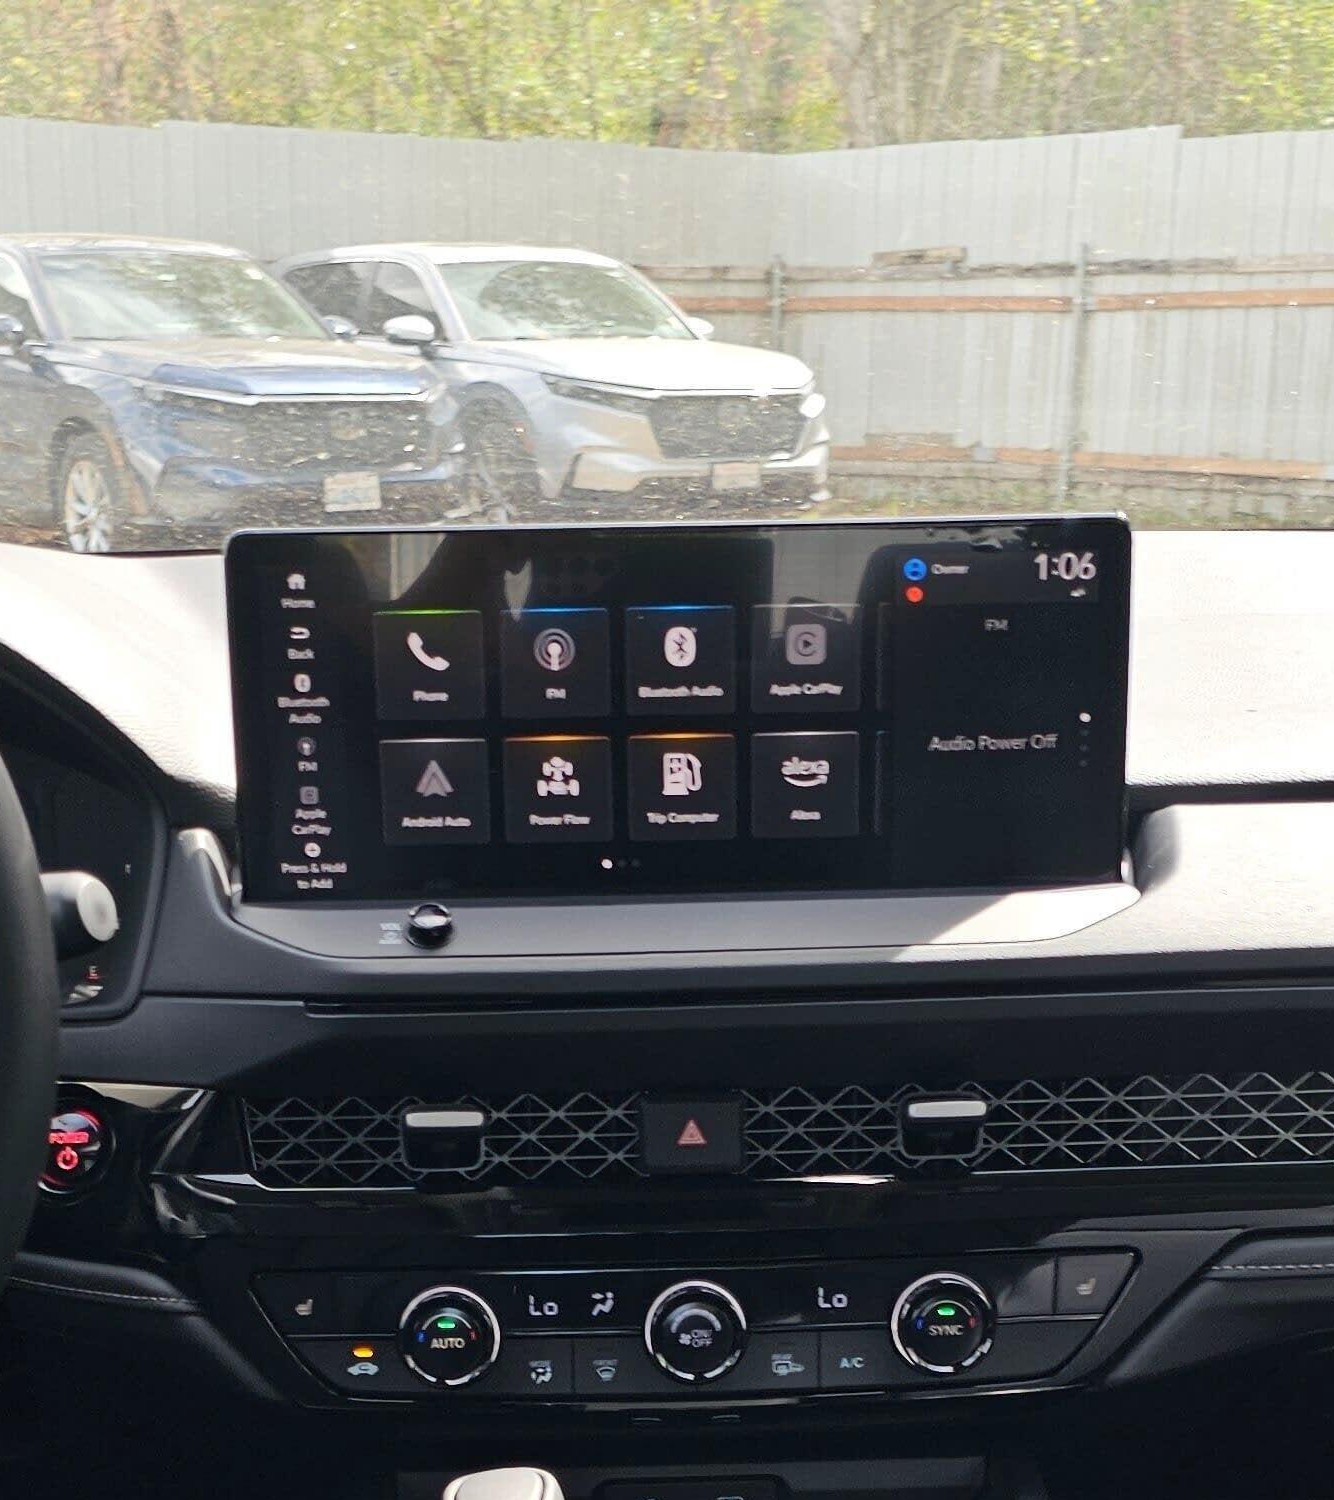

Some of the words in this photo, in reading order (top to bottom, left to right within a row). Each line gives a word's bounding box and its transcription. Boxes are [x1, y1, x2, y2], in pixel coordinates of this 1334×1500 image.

[1034, 552, 1097, 581] 1:06
[280, 598, 316, 608] Home
[984, 619, 1008, 631] FM
[287, 648, 315, 660] Back
[545, 687, 566, 699] FM
[638, 685, 690, 698] Bluetooth
[691, 685, 724, 698] Audio
[769, 683, 801, 696] Apple
[801, 682, 843, 695] CarPlay
[277, 696, 331, 708] Bluetooth
[412, 690, 449, 702] Phone
[288, 713, 322, 724] Audio
[927, 735, 976, 751] Audio
[977, 734, 1028, 751] Power
[1029, 733, 1059, 750] Off
[297, 760, 318, 772] FM
[781, 757, 830, 775] alexa
[294, 808, 328, 820] Apple
[529, 814, 562, 826] Power
[563, 814, 591, 825] Flow
[647, 812, 667, 825] Trip
[667, 811, 719, 823] Computer
[790, 810, 821, 821] Alexa
[401, 816, 443, 828] Android
[444, 816, 471, 827] Auto
[291, 824, 332, 835] CarPlay
[281, 863, 309, 874] Press
[320, 862, 347, 873] Hold
[311, 878, 334, 889] Add
[928, 1323, 964, 1337] SYNC
[430, 1336, 466, 1350] AUTO
[691, 1338, 713, 1348] OFF
[839, 1356, 866, 1369] A/C
